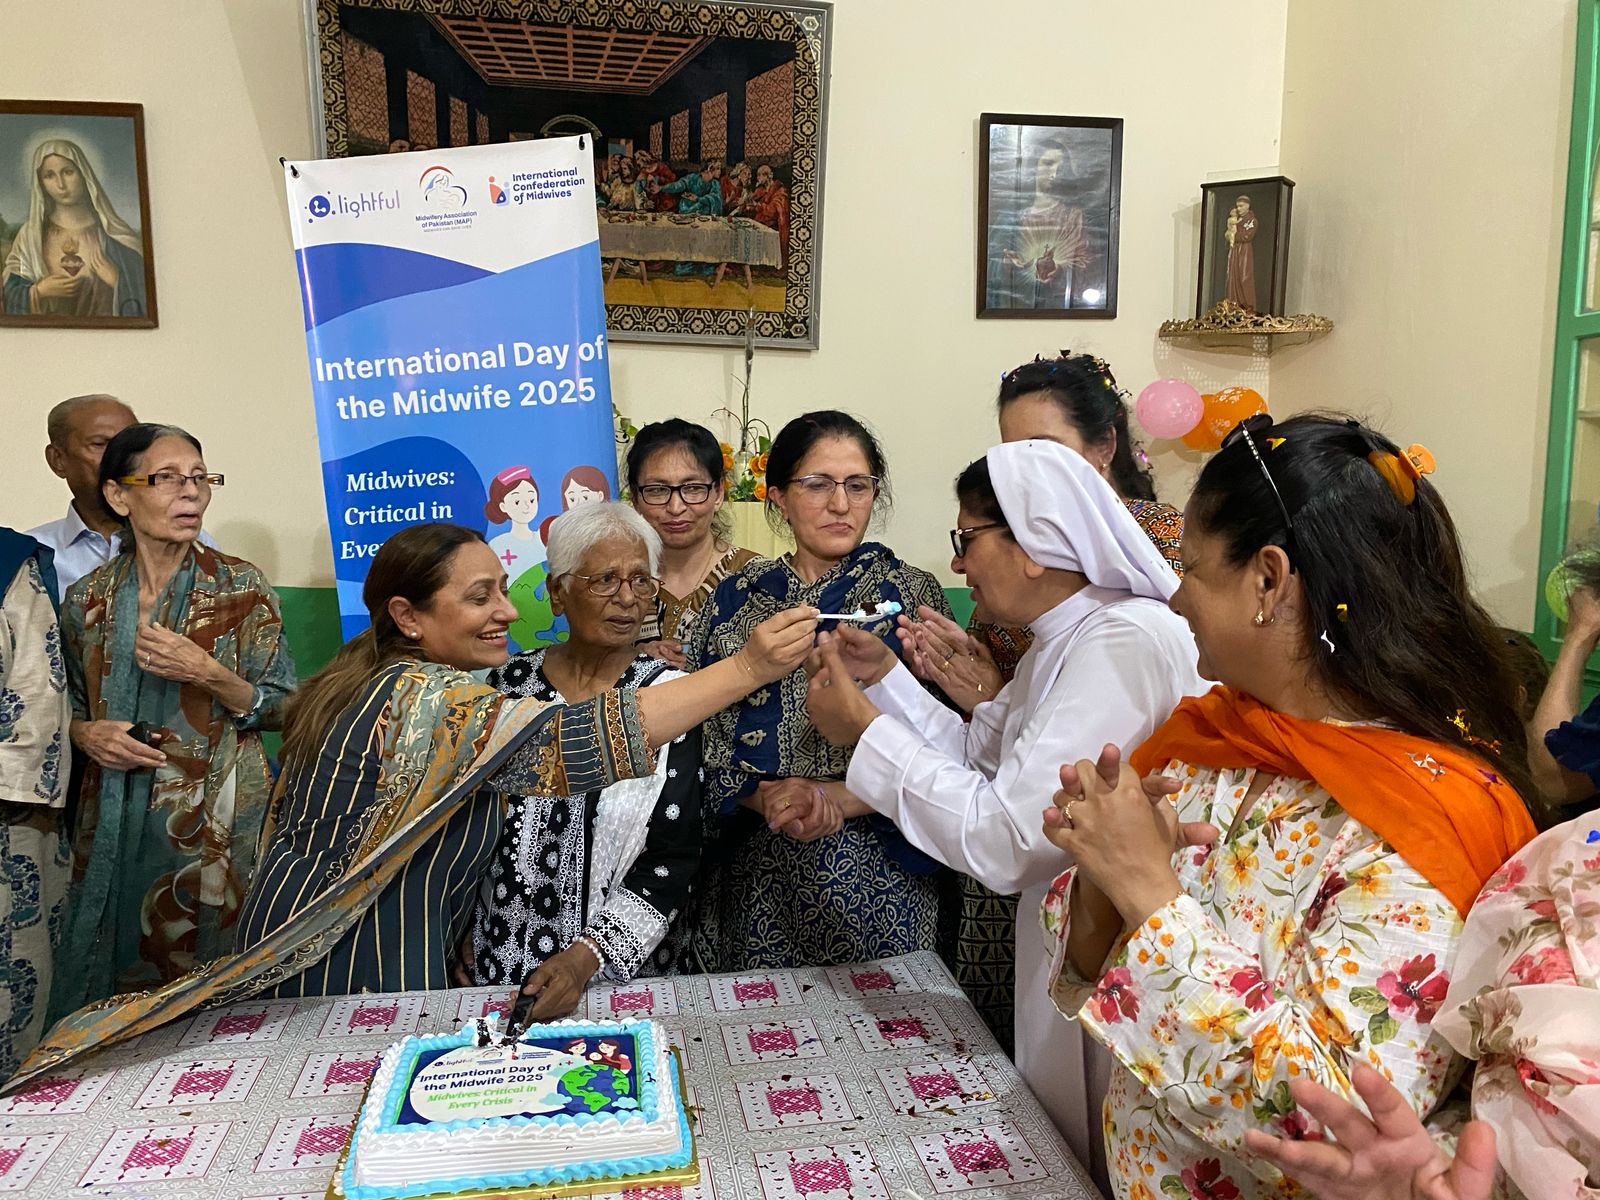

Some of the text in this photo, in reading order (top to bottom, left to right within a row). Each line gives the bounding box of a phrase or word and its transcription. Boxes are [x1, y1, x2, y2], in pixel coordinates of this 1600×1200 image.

[512, 167, 578, 182] International
[512, 177, 585, 192] Confederation
[338, 189, 400, 218] lightful
[513, 189, 572, 205] of Midwives
[428, 219, 454, 227] Pakistan
[454, 217, 473, 226] (MAP)
[443, 211, 478, 219] Association
[315, 334, 605, 382] International Day of
[336, 377, 596, 420] the Midwife 2025
[346, 470, 456, 493] Midwives:
[344, 501, 454, 526] Critical in
[340, 540, 384, 560] Eve
[420, 1067, 506, 1083] International
[509, 1065, 535, 1074] Day
[424, 1074, 543, 1091] the Midwife 2025
[483, 1085, 524, 1097] Critical
[526, 1085, 537, 1093] in
[448, 1096, 513, 1110] Every Crisis
